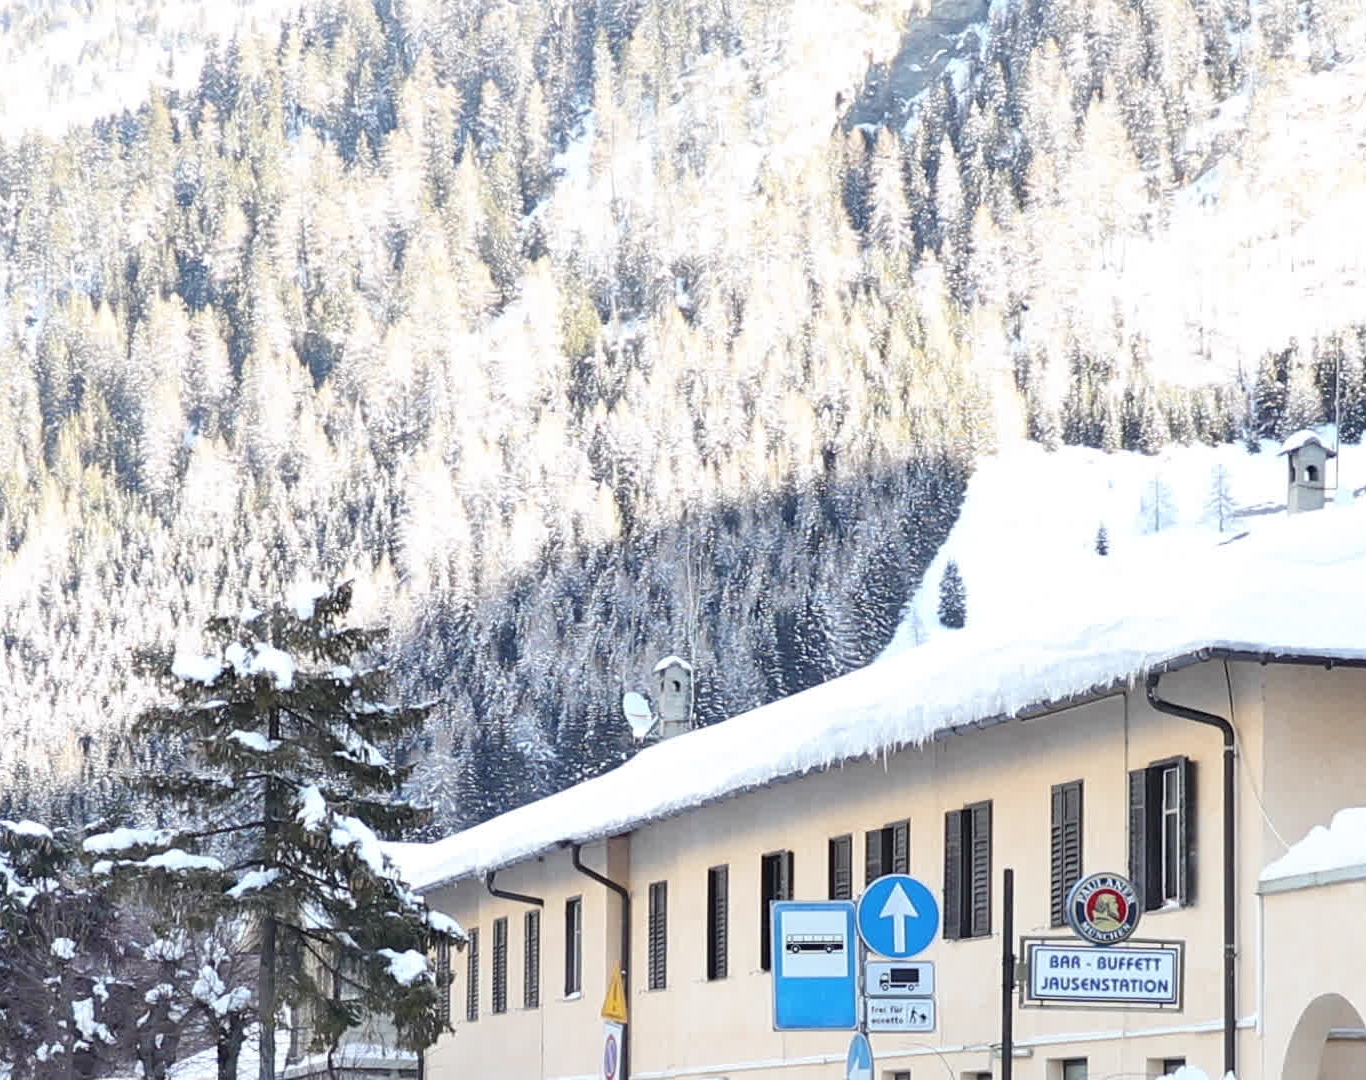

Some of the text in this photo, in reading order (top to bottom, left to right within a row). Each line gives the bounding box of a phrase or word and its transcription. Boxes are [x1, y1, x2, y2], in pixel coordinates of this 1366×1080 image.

[1077, 877, 1136, 905] PAULANER
[1081, 921, 1132, 942] MÜNCHEN
[1049, 955, 1081, 969] BAR
[1097, 956, 1162, 972] BUFFETT
[1041, 976, 1169, 993] JAUSENSTATION
